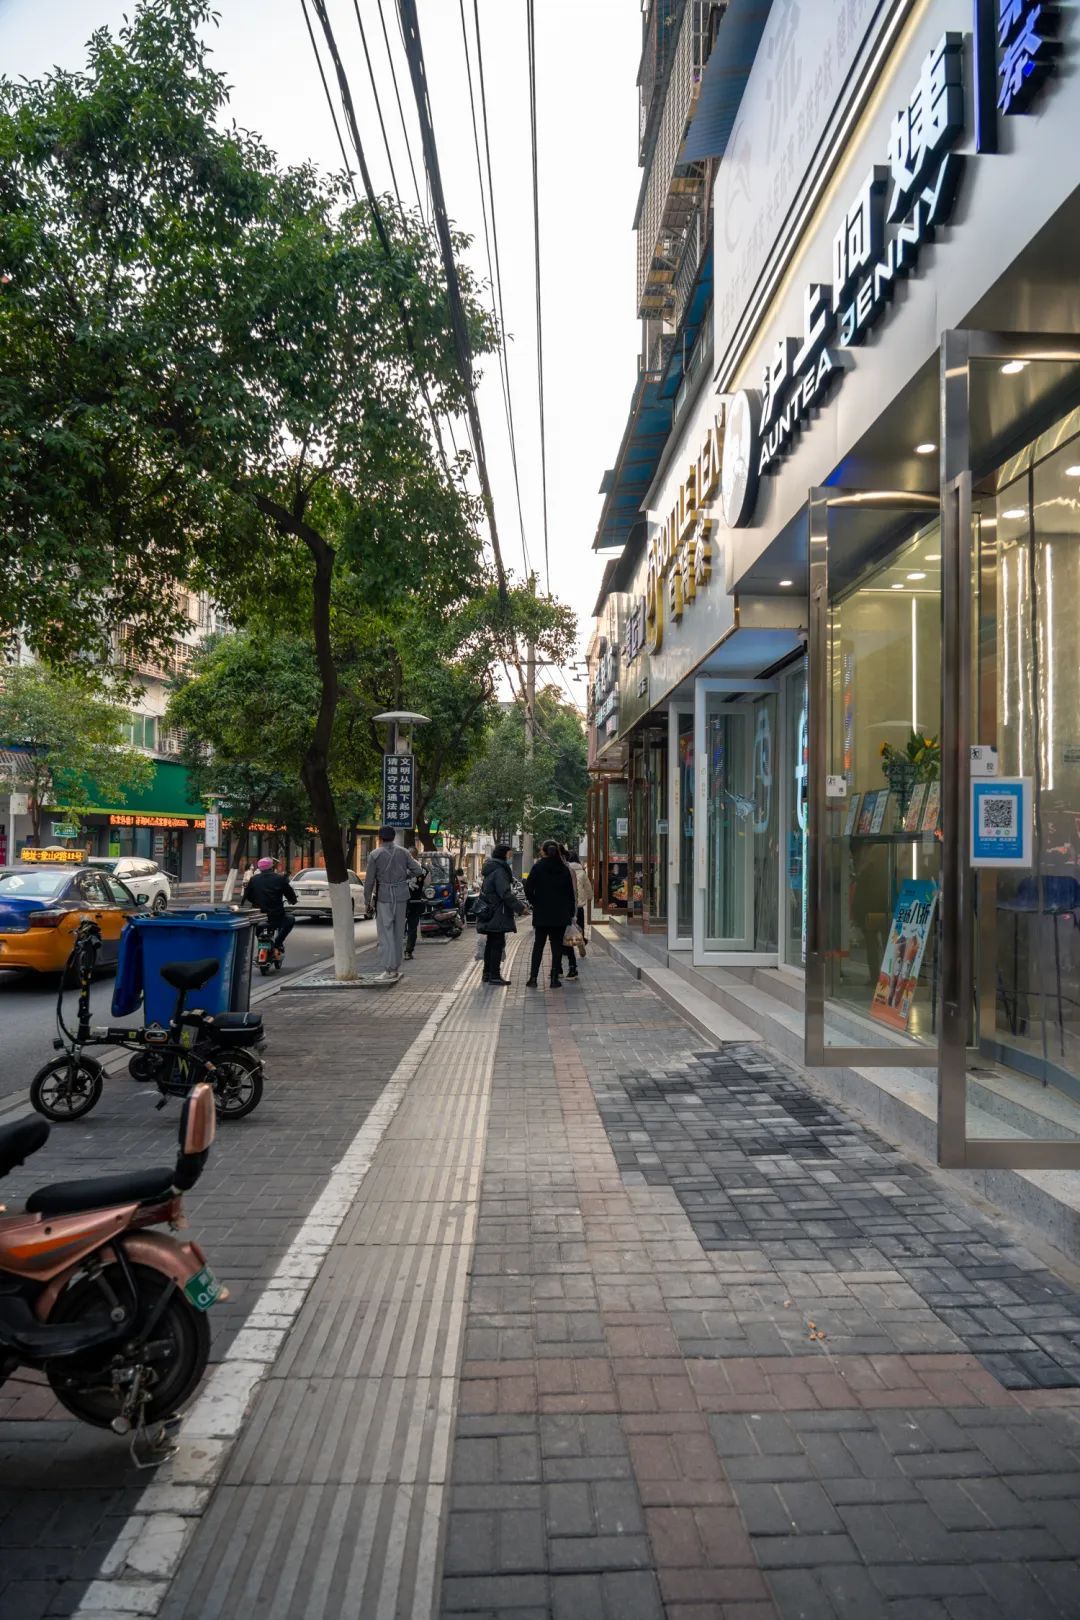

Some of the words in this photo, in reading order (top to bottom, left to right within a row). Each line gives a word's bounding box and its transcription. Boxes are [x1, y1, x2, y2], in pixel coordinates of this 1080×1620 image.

[759, 32, 950, 437] 沪上阿姨
[758, 347, 832, 476] AUNTEA
[840, 153, 950, 347] JENNY
[387, 757, 398, 820] 请遵守交通法规
[399, 757, 411, 820] 文明从脚下起步
[896, 902, 932, 925] 全场八折
